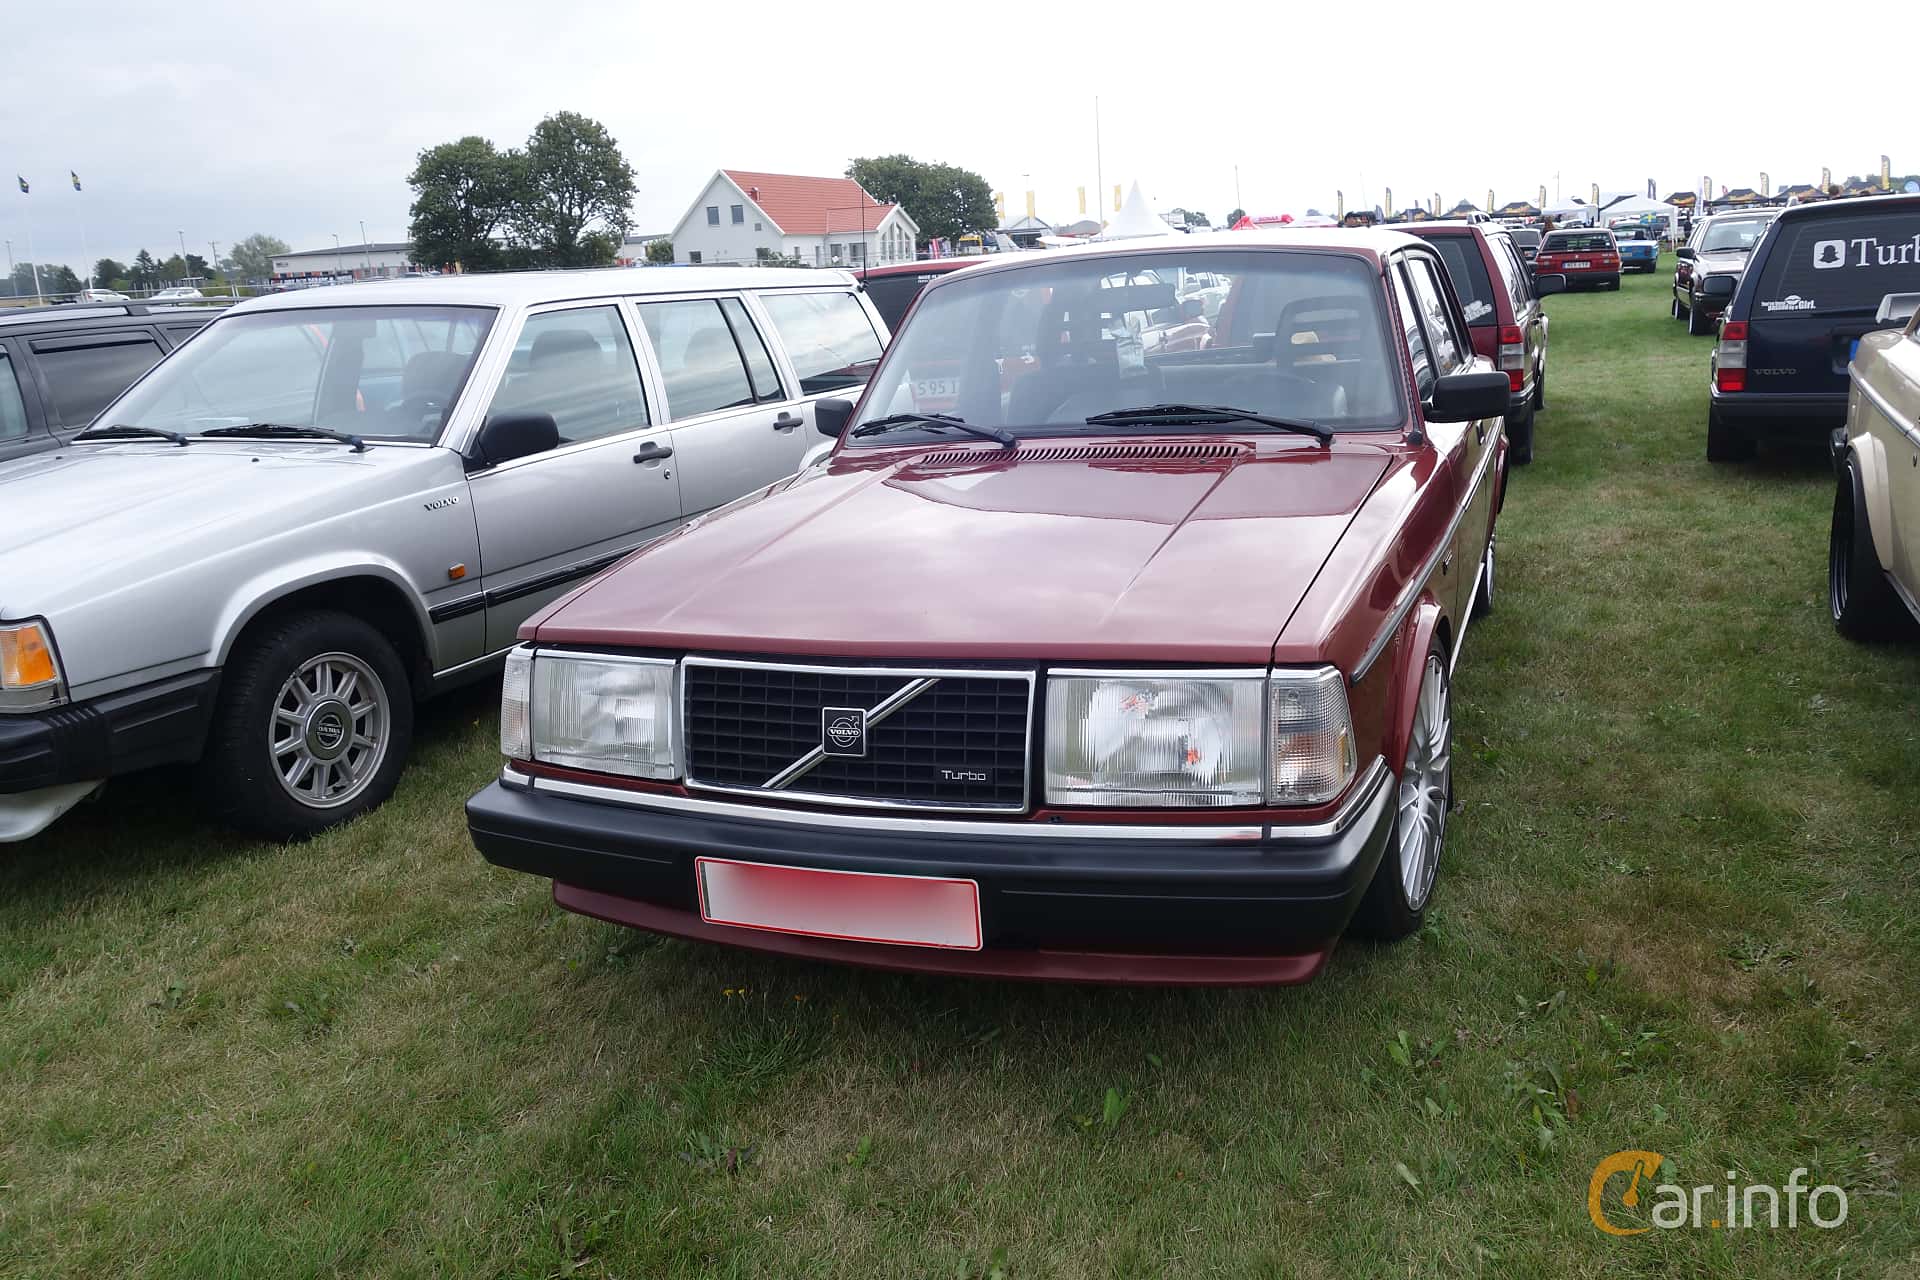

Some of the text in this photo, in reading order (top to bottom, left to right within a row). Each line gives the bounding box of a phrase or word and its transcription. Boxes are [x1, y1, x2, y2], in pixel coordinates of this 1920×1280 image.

[1752, 368, 1796, 376] VOLVO
[423, 496, 459, 511] VOLVO
[940, 769, 986, 781] Turbo
